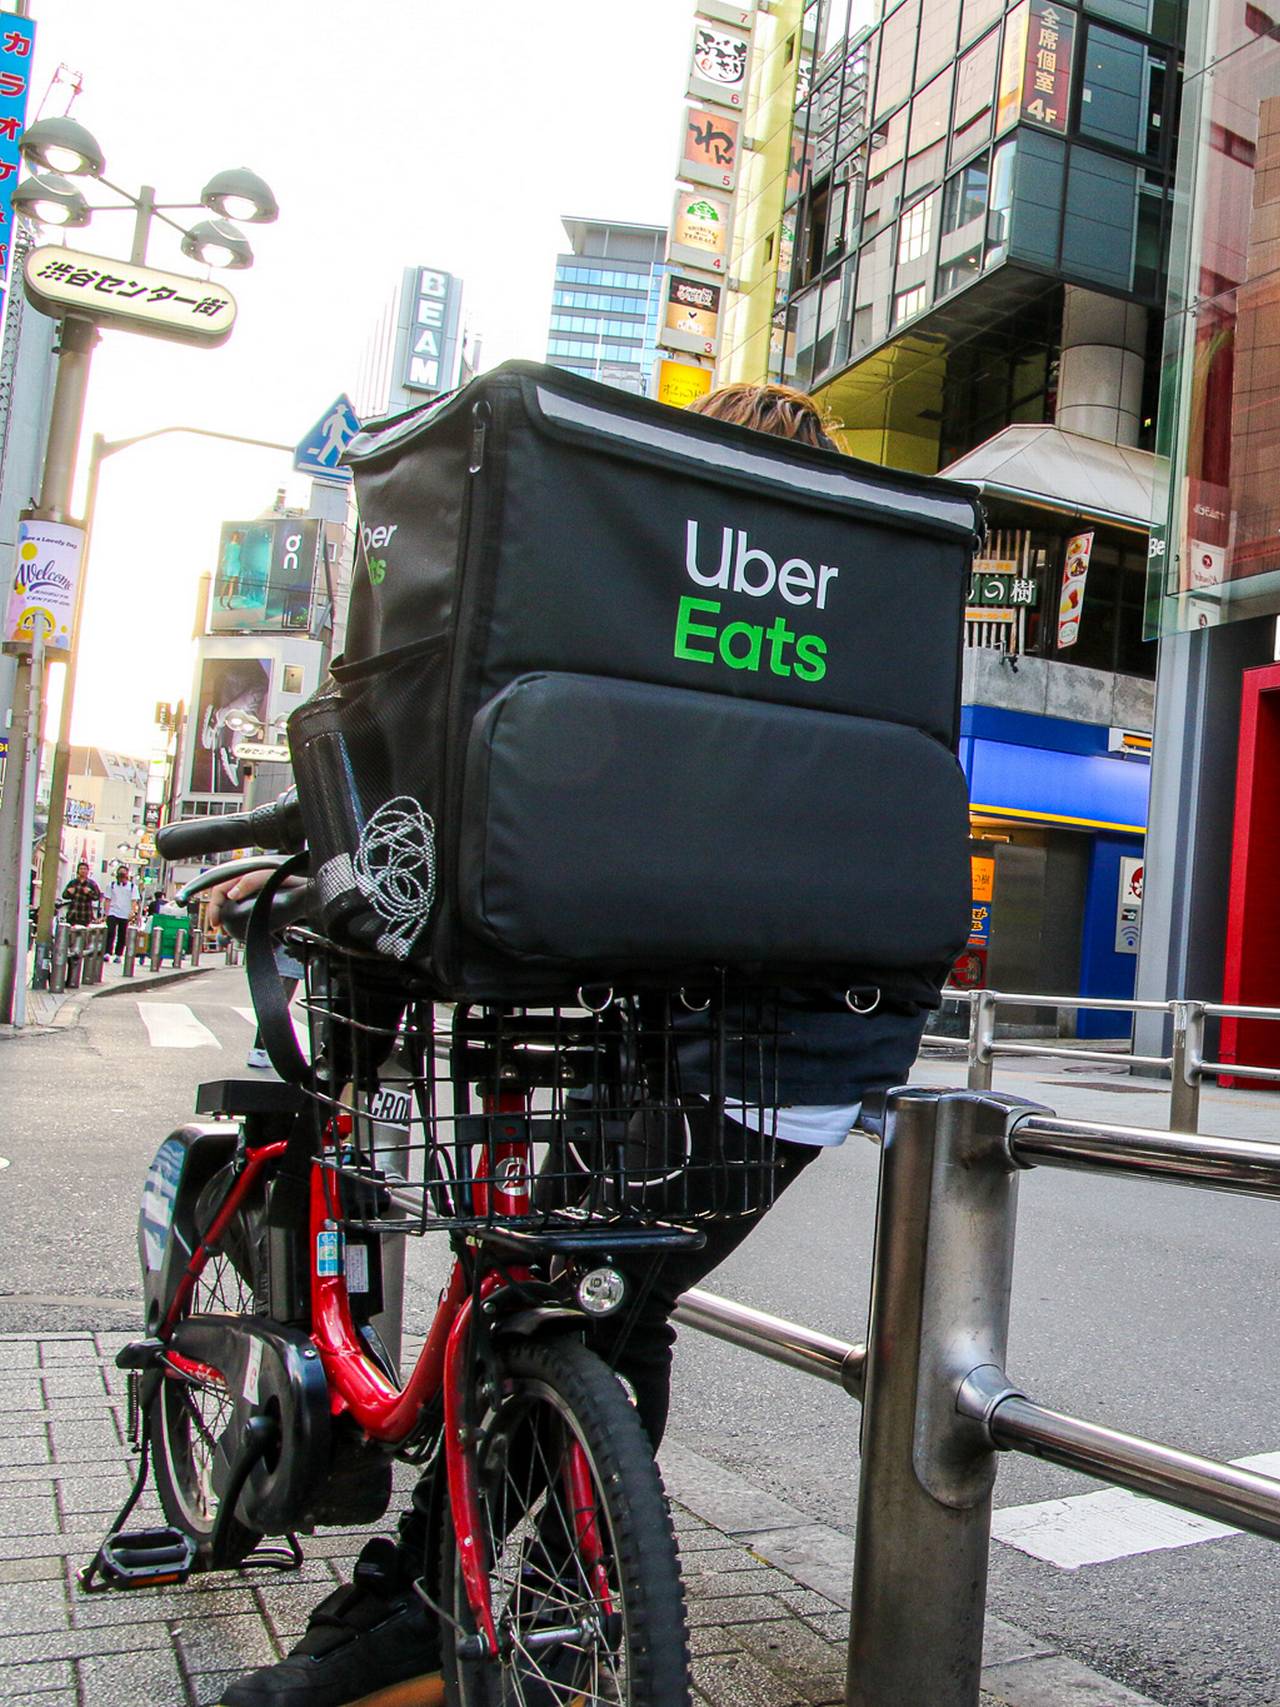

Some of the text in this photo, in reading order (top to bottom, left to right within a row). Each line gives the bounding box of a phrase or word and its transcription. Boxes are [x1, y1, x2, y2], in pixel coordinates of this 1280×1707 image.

[1036, 7, 1060, 95] 全席個室
[731, 94, 740, 104] 6
[1027, 98, 1058, 123] 4F
[722, 176, 731, 186] 5
[713, 259, 721, 269] 4
[37, 260, 229, 317] 渋谷センター街
[410, 270, 449, 386] BEAM
[704, 343, 713, 353] 3
[14, 560, 73, 591] Welcome
[684, 519, 839, 610] Uber
[968, 579, 1035, 604] の樹
[674, 596, 829, 683] Eats
